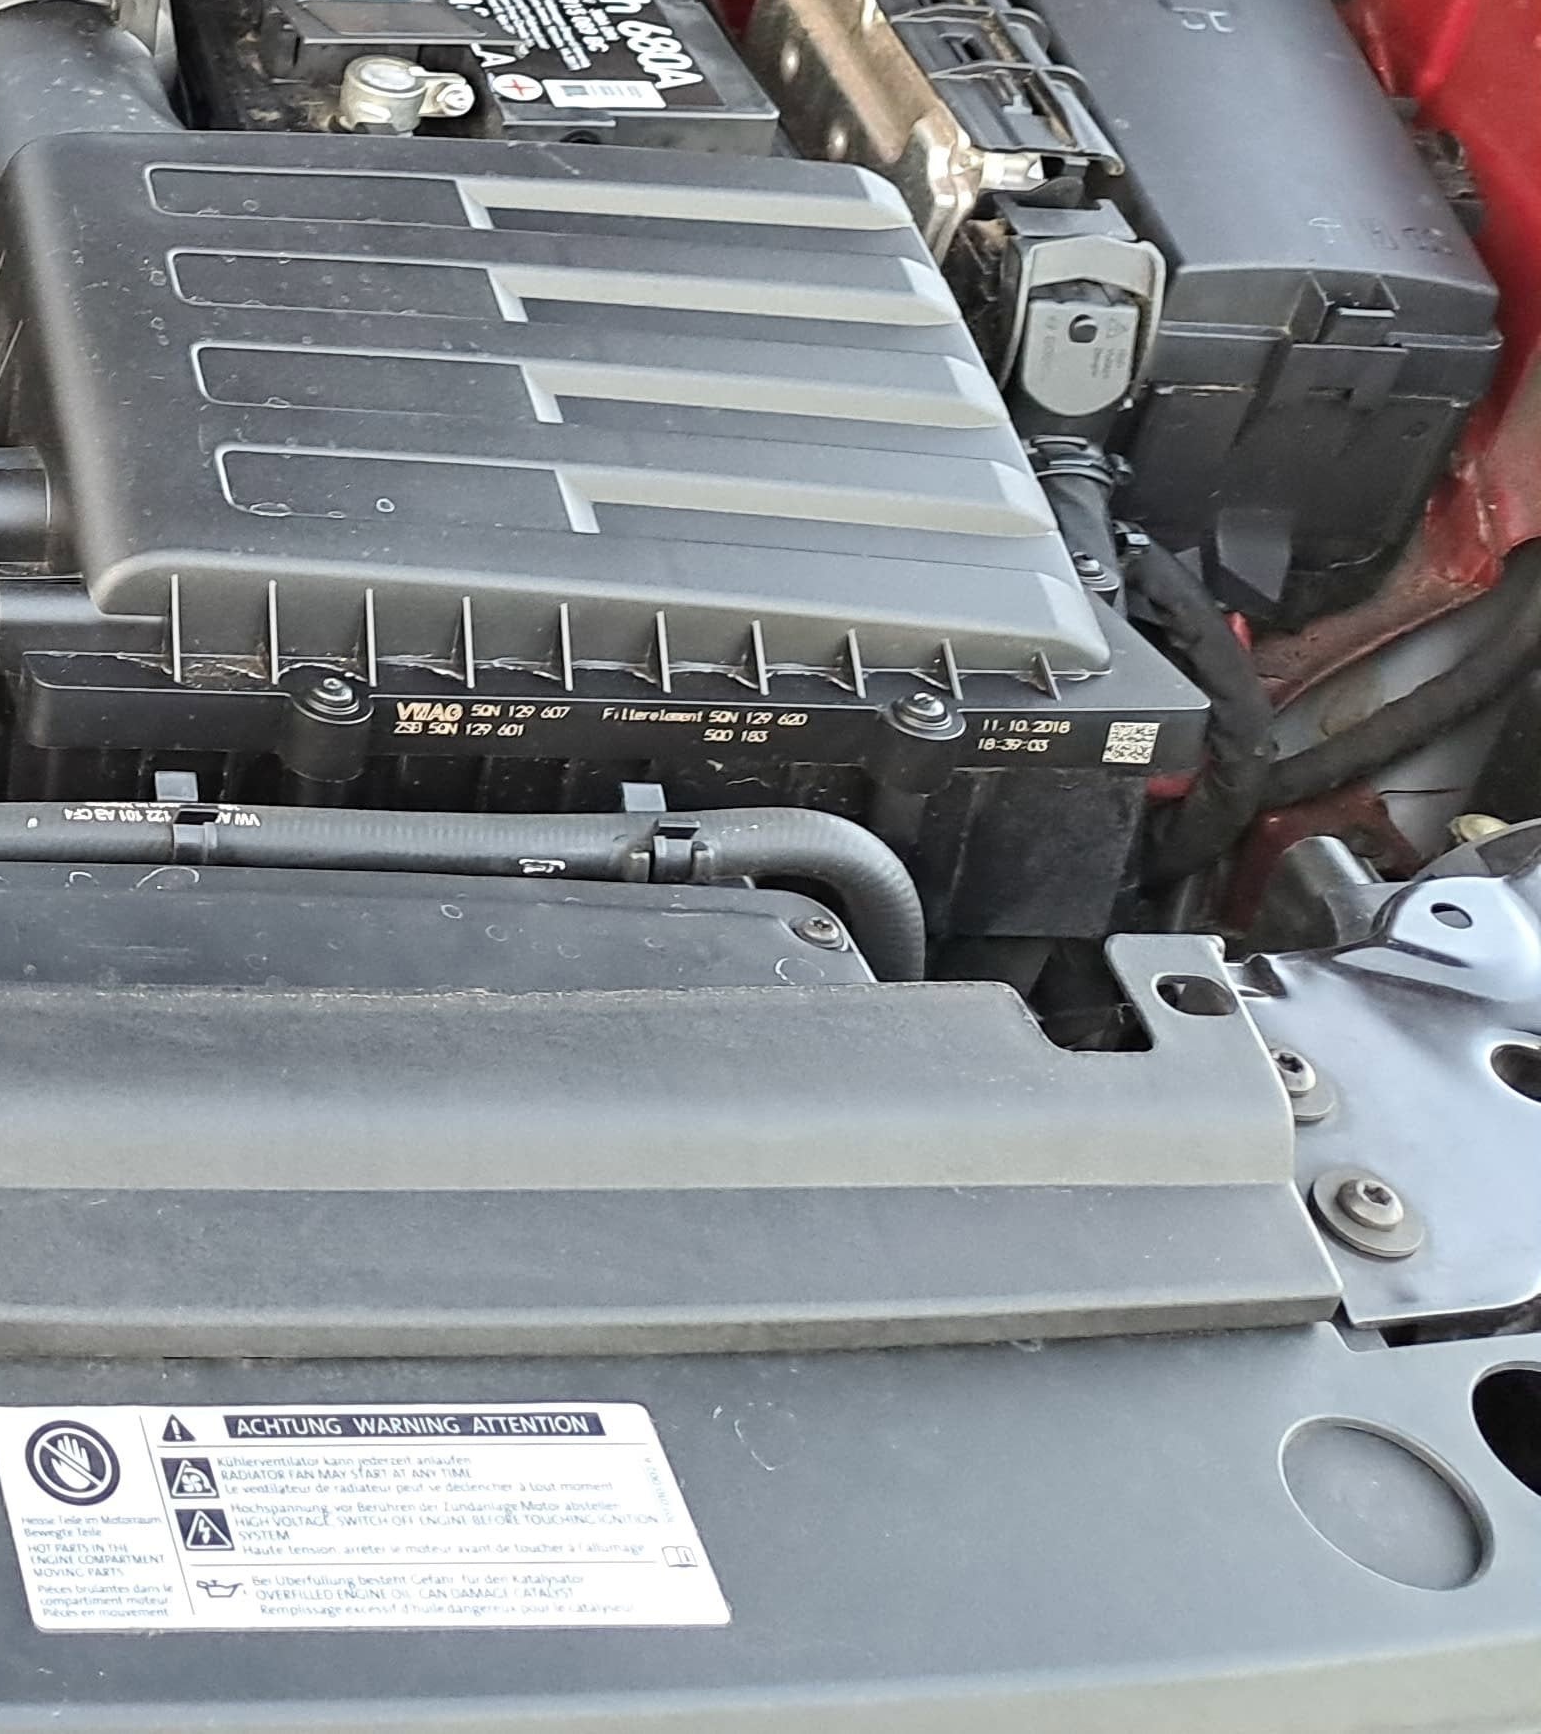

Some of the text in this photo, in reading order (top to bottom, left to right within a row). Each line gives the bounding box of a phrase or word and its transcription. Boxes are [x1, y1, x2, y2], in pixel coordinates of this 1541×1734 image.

[620, 19, 704, 90] 680A
[508, 706, 536, 719] 129
[540, 706, 571, 719] 607
[601, 707, 704, 722] Filterelement
[746, 711, 773, 724] 129
[777, 712, 808, 726] 620
[465, 722, 493, 735] 129
[497, 723, 524, 736] 601
[978, 738, 1050, 752] 18:39:03
[237, 1415, 590, 1436] ACHTUNG WARNING ATTENTION
[221, 1467, 471, 1481] RADIATOR FAN MAY START AT ANY TIME
[315, 1483, 330, 1494] de
[520, 1500, 560, 1511] Motor
[235, 1516, 269, 1527] HIGH
[336, 1515, 388, 1527] SWITCH
[419, 1515, 467, 1525] ENGINE
[238, 1530, 290, 1540] SYSTEM
[27, 1543, 128, 1554] HOT PARTS IN THE
[30, 1554, 164, 1565] ENGINE COMPARTMENT
[33, 1567, 123, 1578] MOVING PARTS
[255, 1589, 333, 1601] OVERFILLED
[337, 1587, 386, 1600] ENGINE
[419, 1588, 448, 1599] CAN
[40, 1596, 123, 1608] compartiment
[99, 1608, 169, 1617] mouvement
